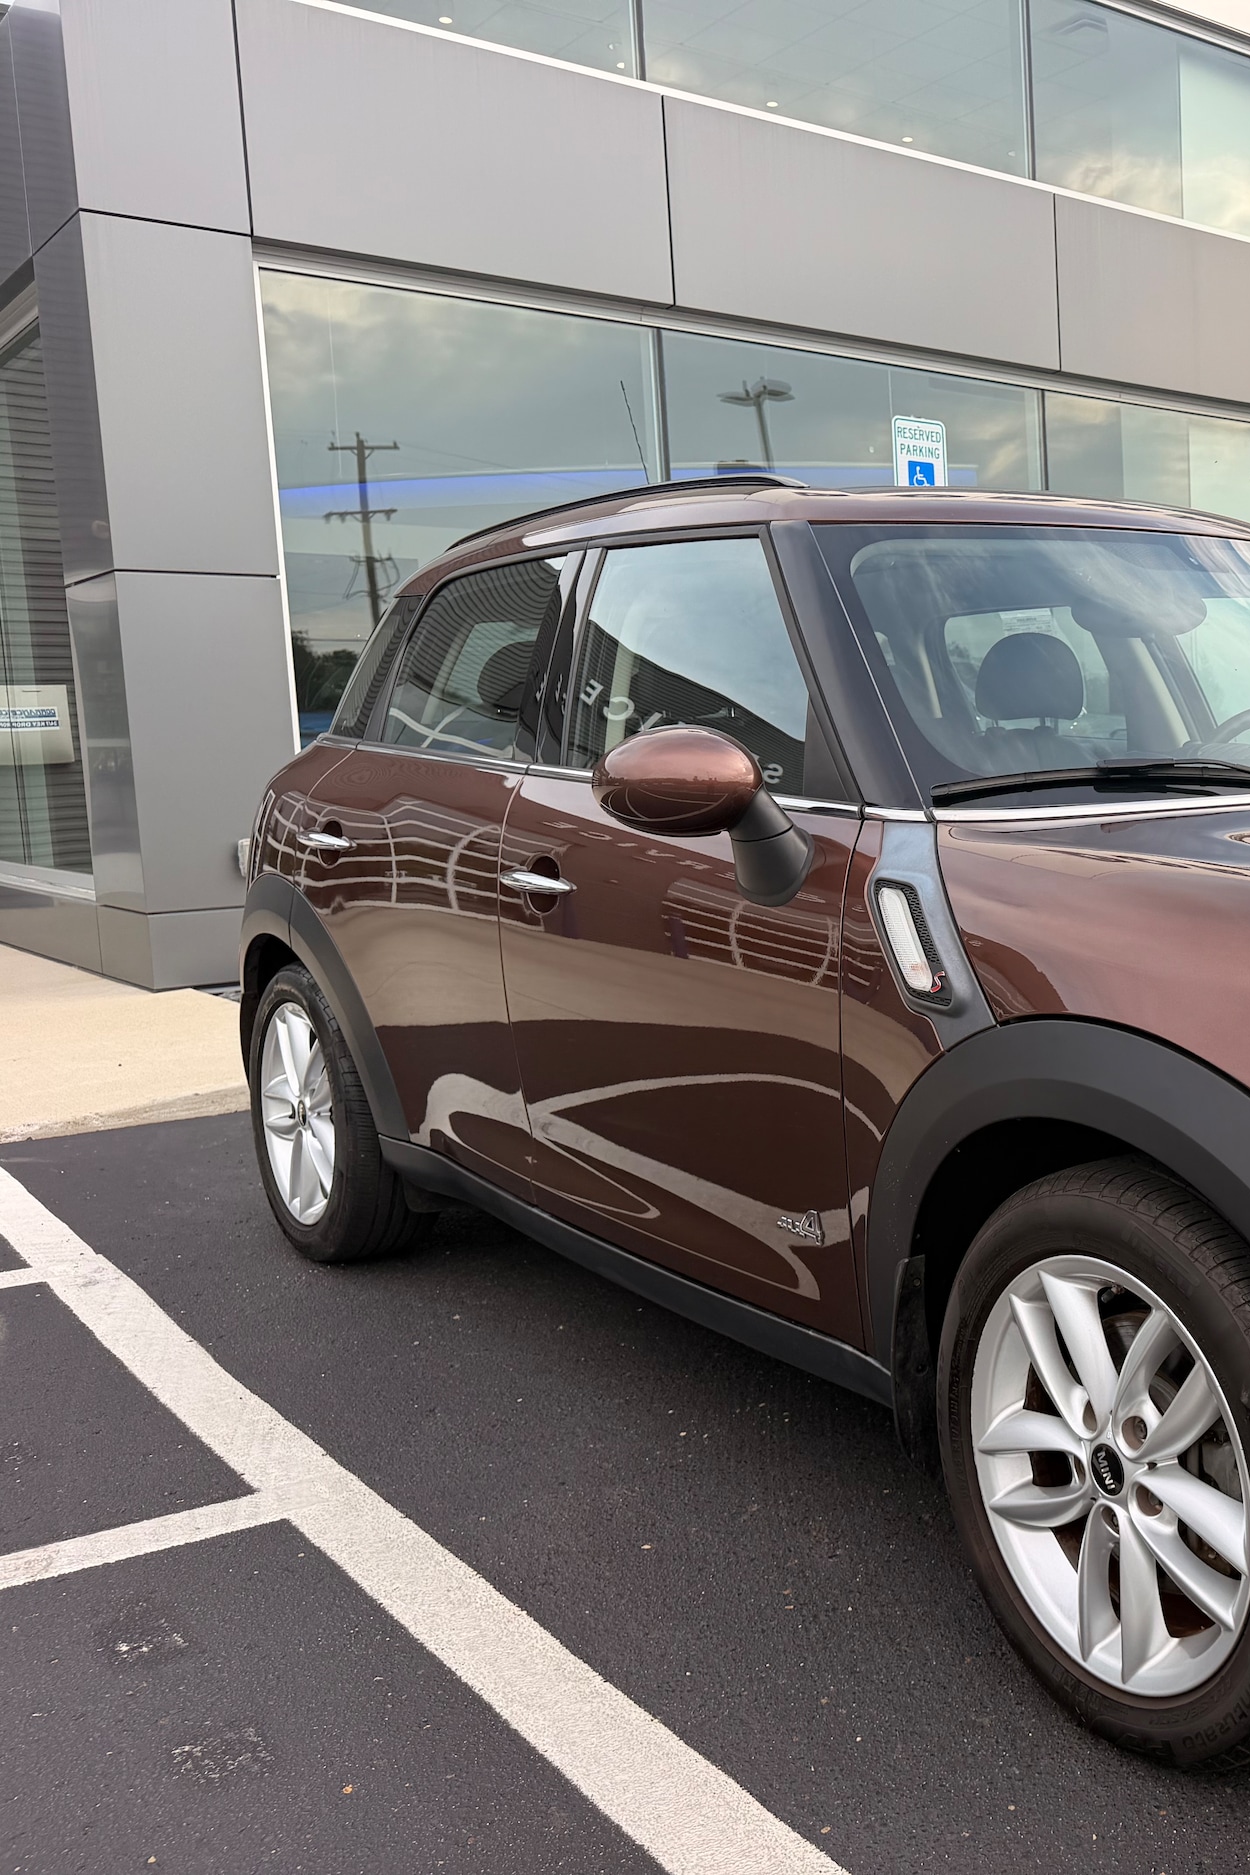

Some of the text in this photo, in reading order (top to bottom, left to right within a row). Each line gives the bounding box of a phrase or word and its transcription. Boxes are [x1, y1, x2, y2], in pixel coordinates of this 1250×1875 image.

[897, 426, 941, 443] RESERVED
[899, 443, 940, 459] PARKING
[930, 972, 946, 993] S
[1096, 1450, 1116, 1491] MINI
